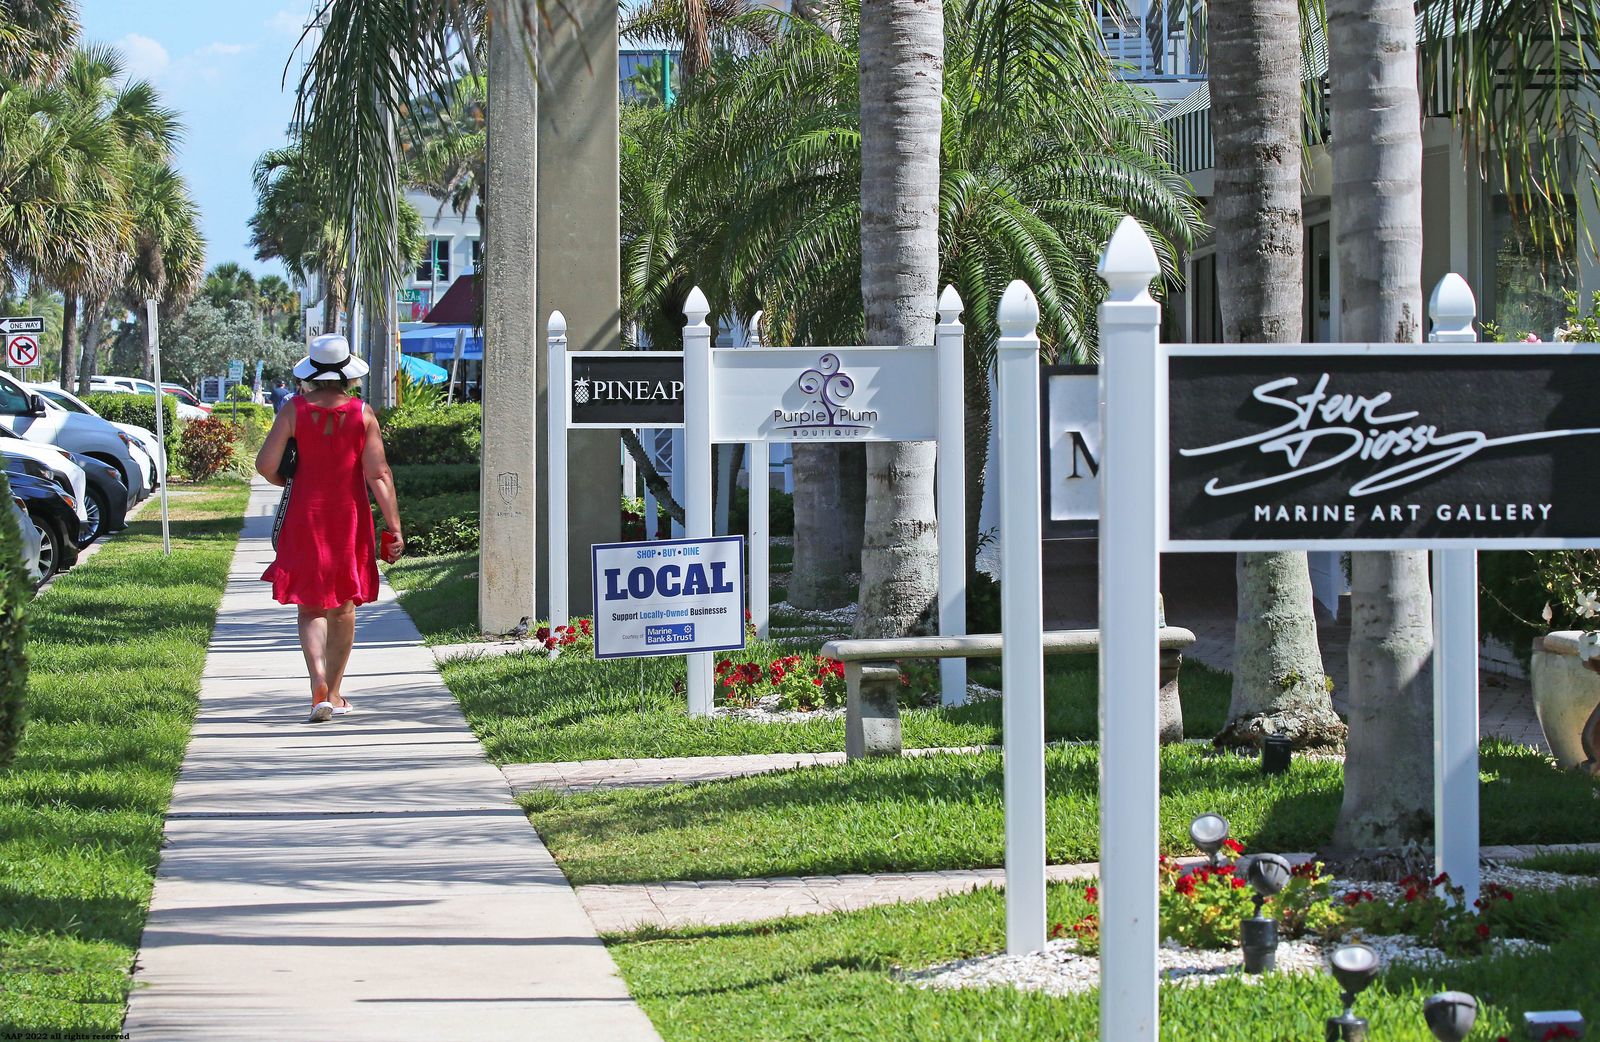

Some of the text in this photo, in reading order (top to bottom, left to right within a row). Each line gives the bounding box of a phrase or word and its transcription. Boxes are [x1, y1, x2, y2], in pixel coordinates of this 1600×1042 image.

[10, 322, 23, 330] ONE
[592, 380, 684, 400] PINEAP
[774, 408, 878, 425] Purple Plum
[1179, 372, 1419, 457] Steve
[793, 429, 859, 437] BOUTIQUE
[1254, 503, 1553, 522] MARINE ART GALLERY
[636, 546, 700, 559] SHOP BUY DINE
[604, 561, 733, 601] LOCAL
[612, 606, 727, 621] Support Locally-Owned Businesses
[647, 627, 672, 635] Marine
[647, 635, 666, 643] Bank
[672, 633, 692, 641] Trust
